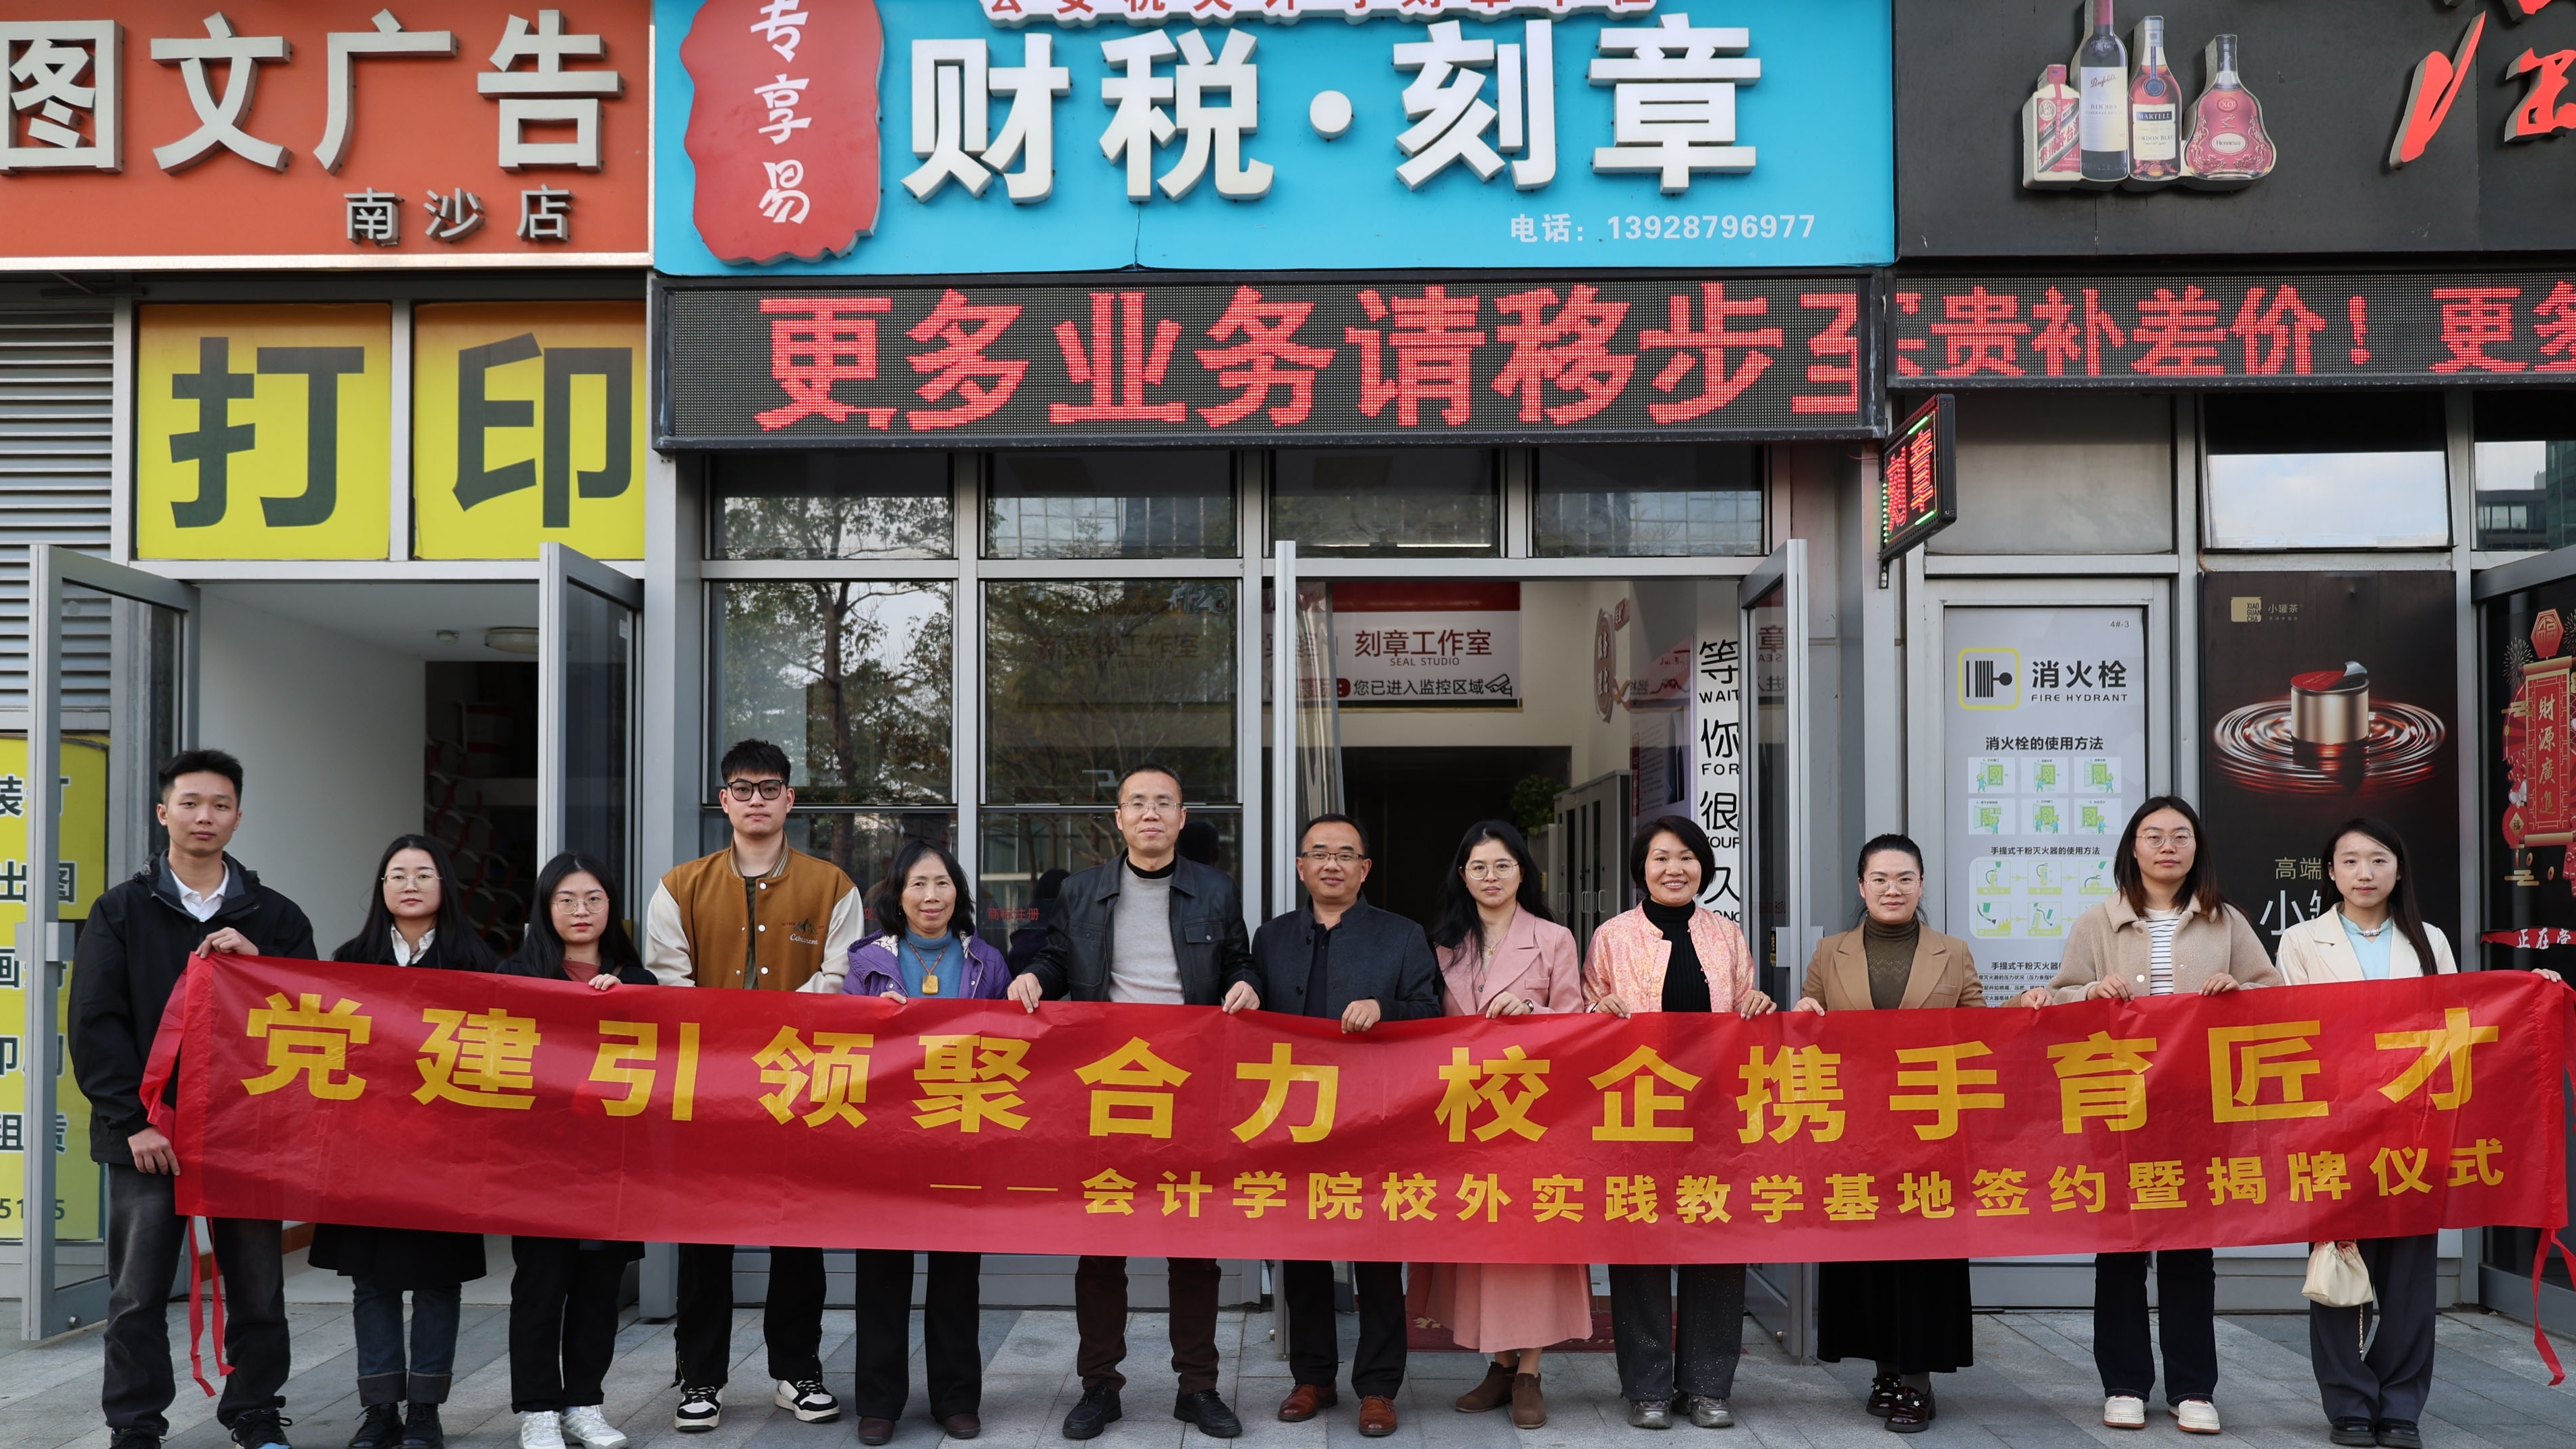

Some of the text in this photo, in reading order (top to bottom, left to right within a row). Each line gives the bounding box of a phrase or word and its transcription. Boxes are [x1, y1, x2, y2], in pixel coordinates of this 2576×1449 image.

[0, 9, 622, 174] 图文广告
[751, 0, 812, 225] 专享易
[344, 185, 575, 245] 南沙店
[169, 333, 633, 528] 打印
[2110, 620, 2130, 628] 4#-3
[1354, 628, 1492, 657] 刻章工作室
[1390, 657, 1460, 666] SEAL STUDIO
[2032, 660, 2127, 688] 消火栓
[1353, 678, 1484, 696] 您已进入监控区域
[2031, 694, 2128, 702] FIRE HYDRANT
[1985, 736, 2104, 750] 消火栓的使用方法
[1701, 763, 1739, 775] FOR
[1991, 846, 2101, 856] 手提式干粉灭火器的使用方法
[988, 908, 1040, 920] 商标注册
[1991, 962, 2061, 970] 手提式干粉灭火器
[240, 993, 2499, 1144] 党建引领聚合力 校企携手育匠才
